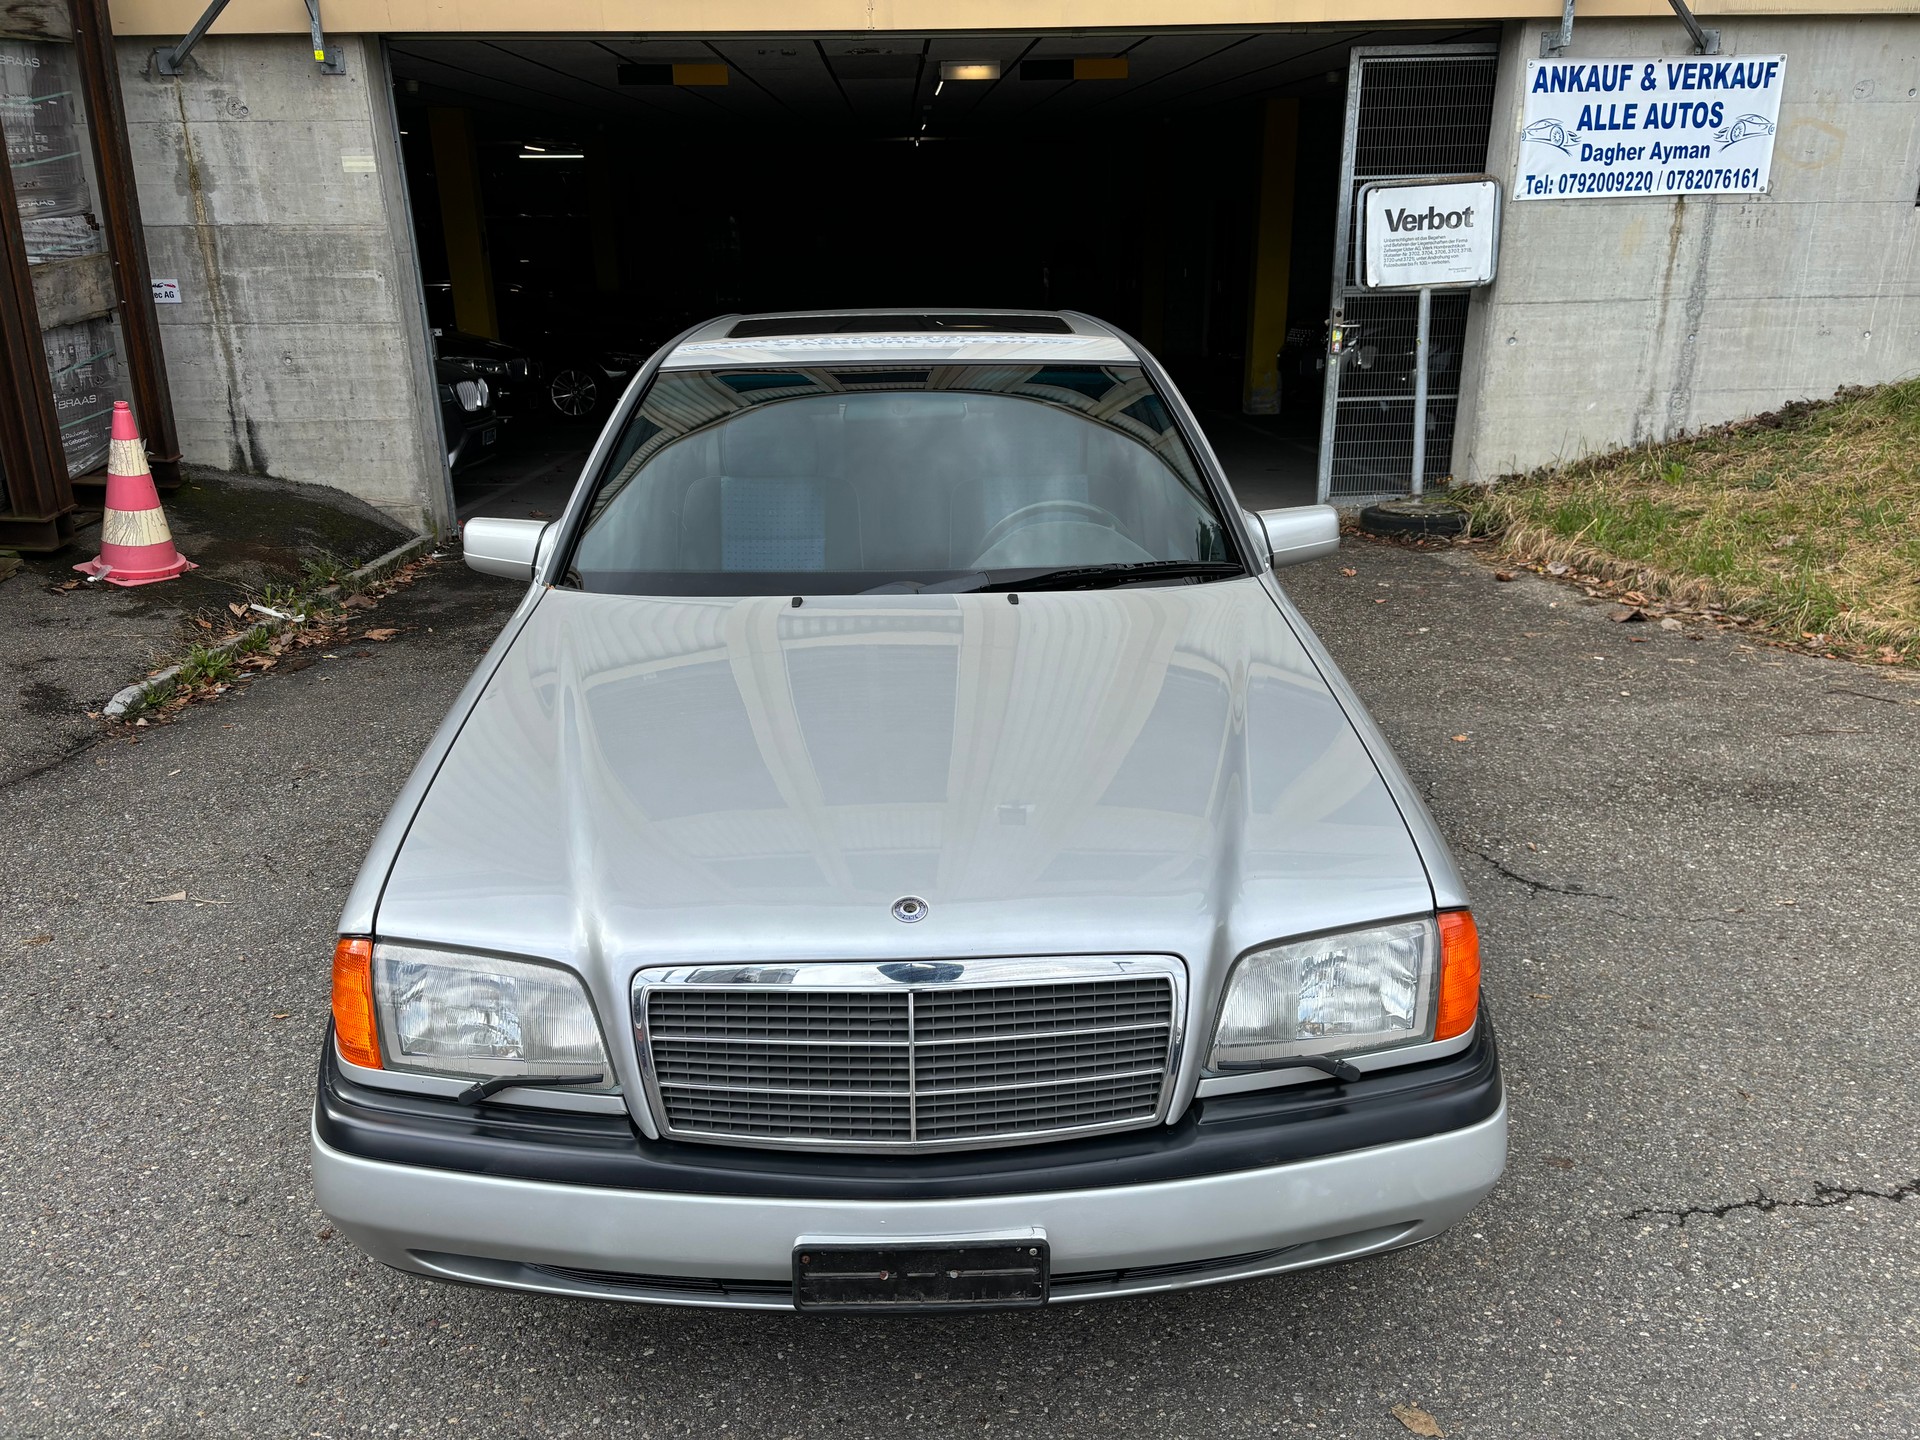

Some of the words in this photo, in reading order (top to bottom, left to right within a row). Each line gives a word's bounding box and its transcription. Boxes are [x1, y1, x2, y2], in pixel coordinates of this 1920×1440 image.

[1532, 64, 1634, 93] ANKAUF
[1640, 63, 1657, 91] &
[1667, 61, 1779, 90] VERKAUF
[1576, 103, 1638, 131] ALLE
[1643, 101, 1724, 129] AUTOS
[1580, 143, 1646, 166] Dagher
[1650, 141, 1711, 164] Ayman
[1526, 174, 1553, 195] Tel:
[1558, 170, 1653, 194] 0792009220
[1657, 171, 1663, 191] /
[1666, 167, 1760, 190] 0782076161
[1384, 205, 1475, 232] Verbot
[164, 290, 175, 298] AG
[58, 394, 97, 410] BRAAS
